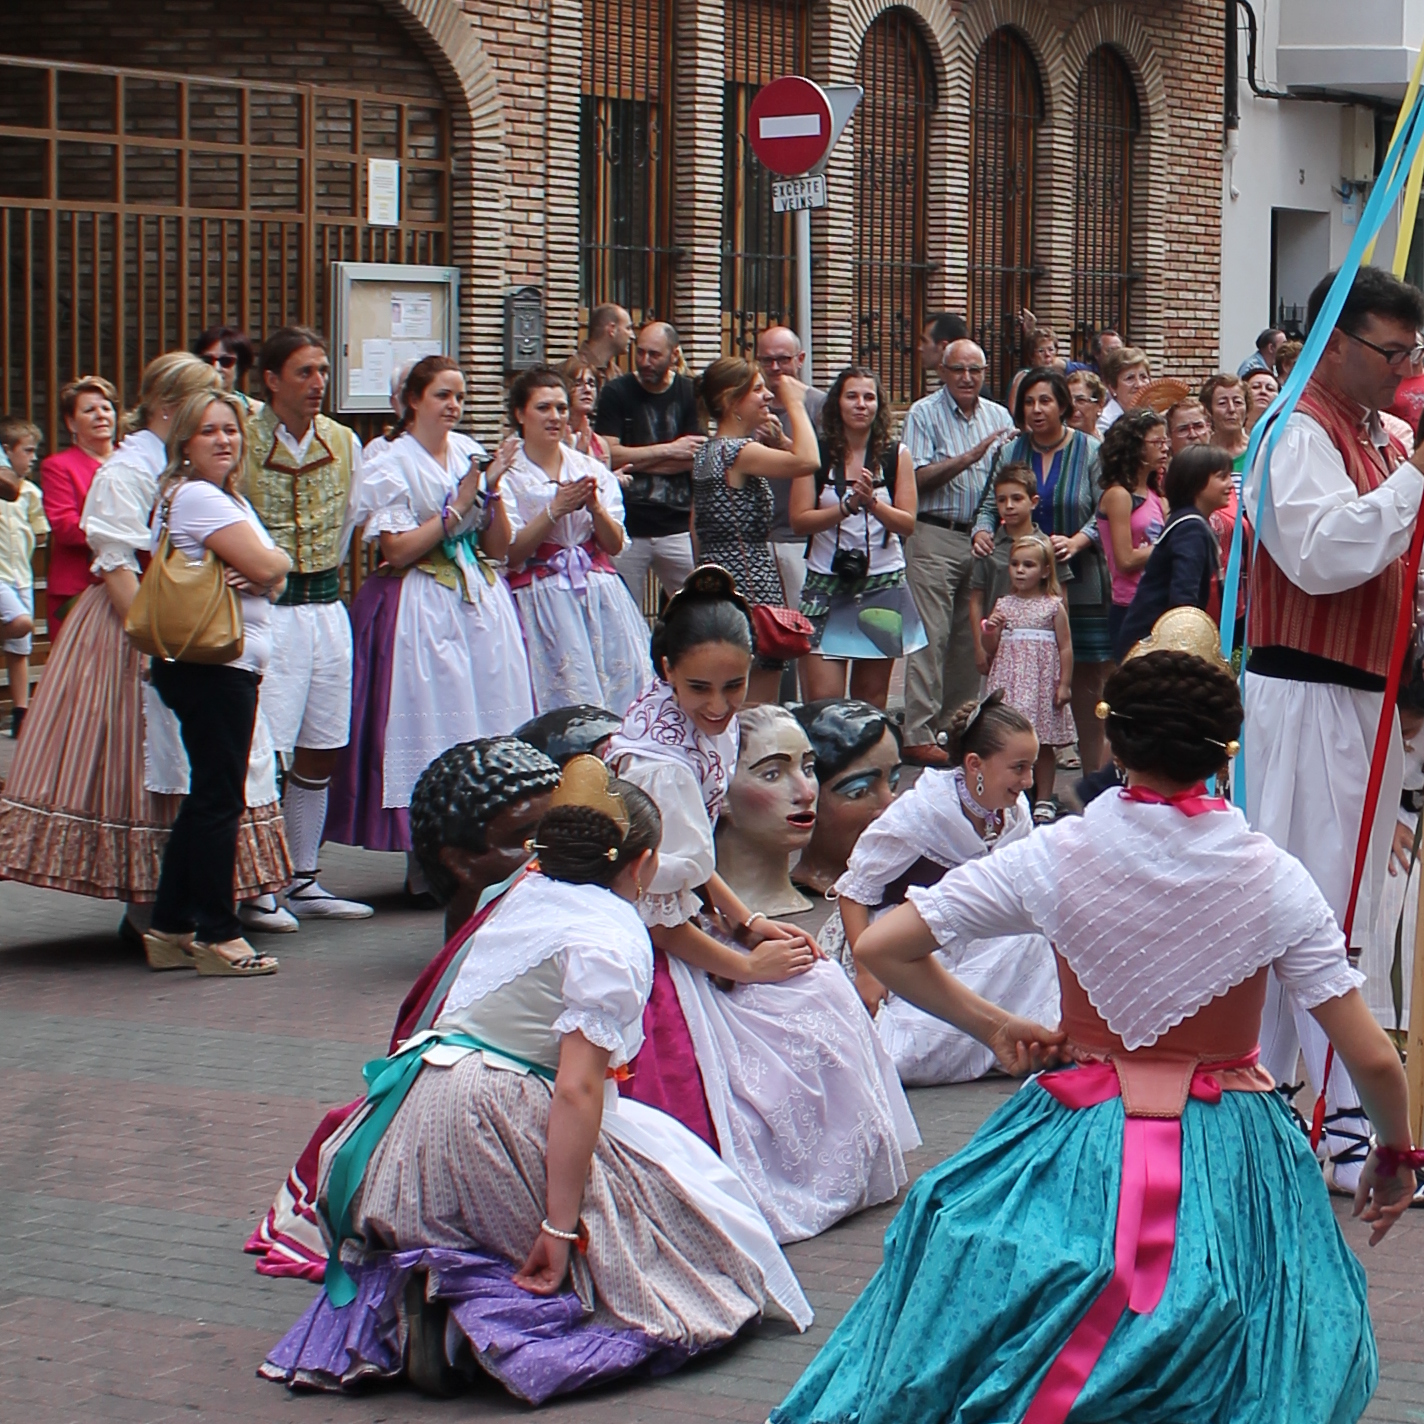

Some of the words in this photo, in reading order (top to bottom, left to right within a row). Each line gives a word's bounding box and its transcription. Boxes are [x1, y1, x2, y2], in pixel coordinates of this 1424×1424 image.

[1299, 168, 1305, 185] 3
[773, 181, 819, 197] EXCEPTE
[781, 196, 813, 210] VEINS
